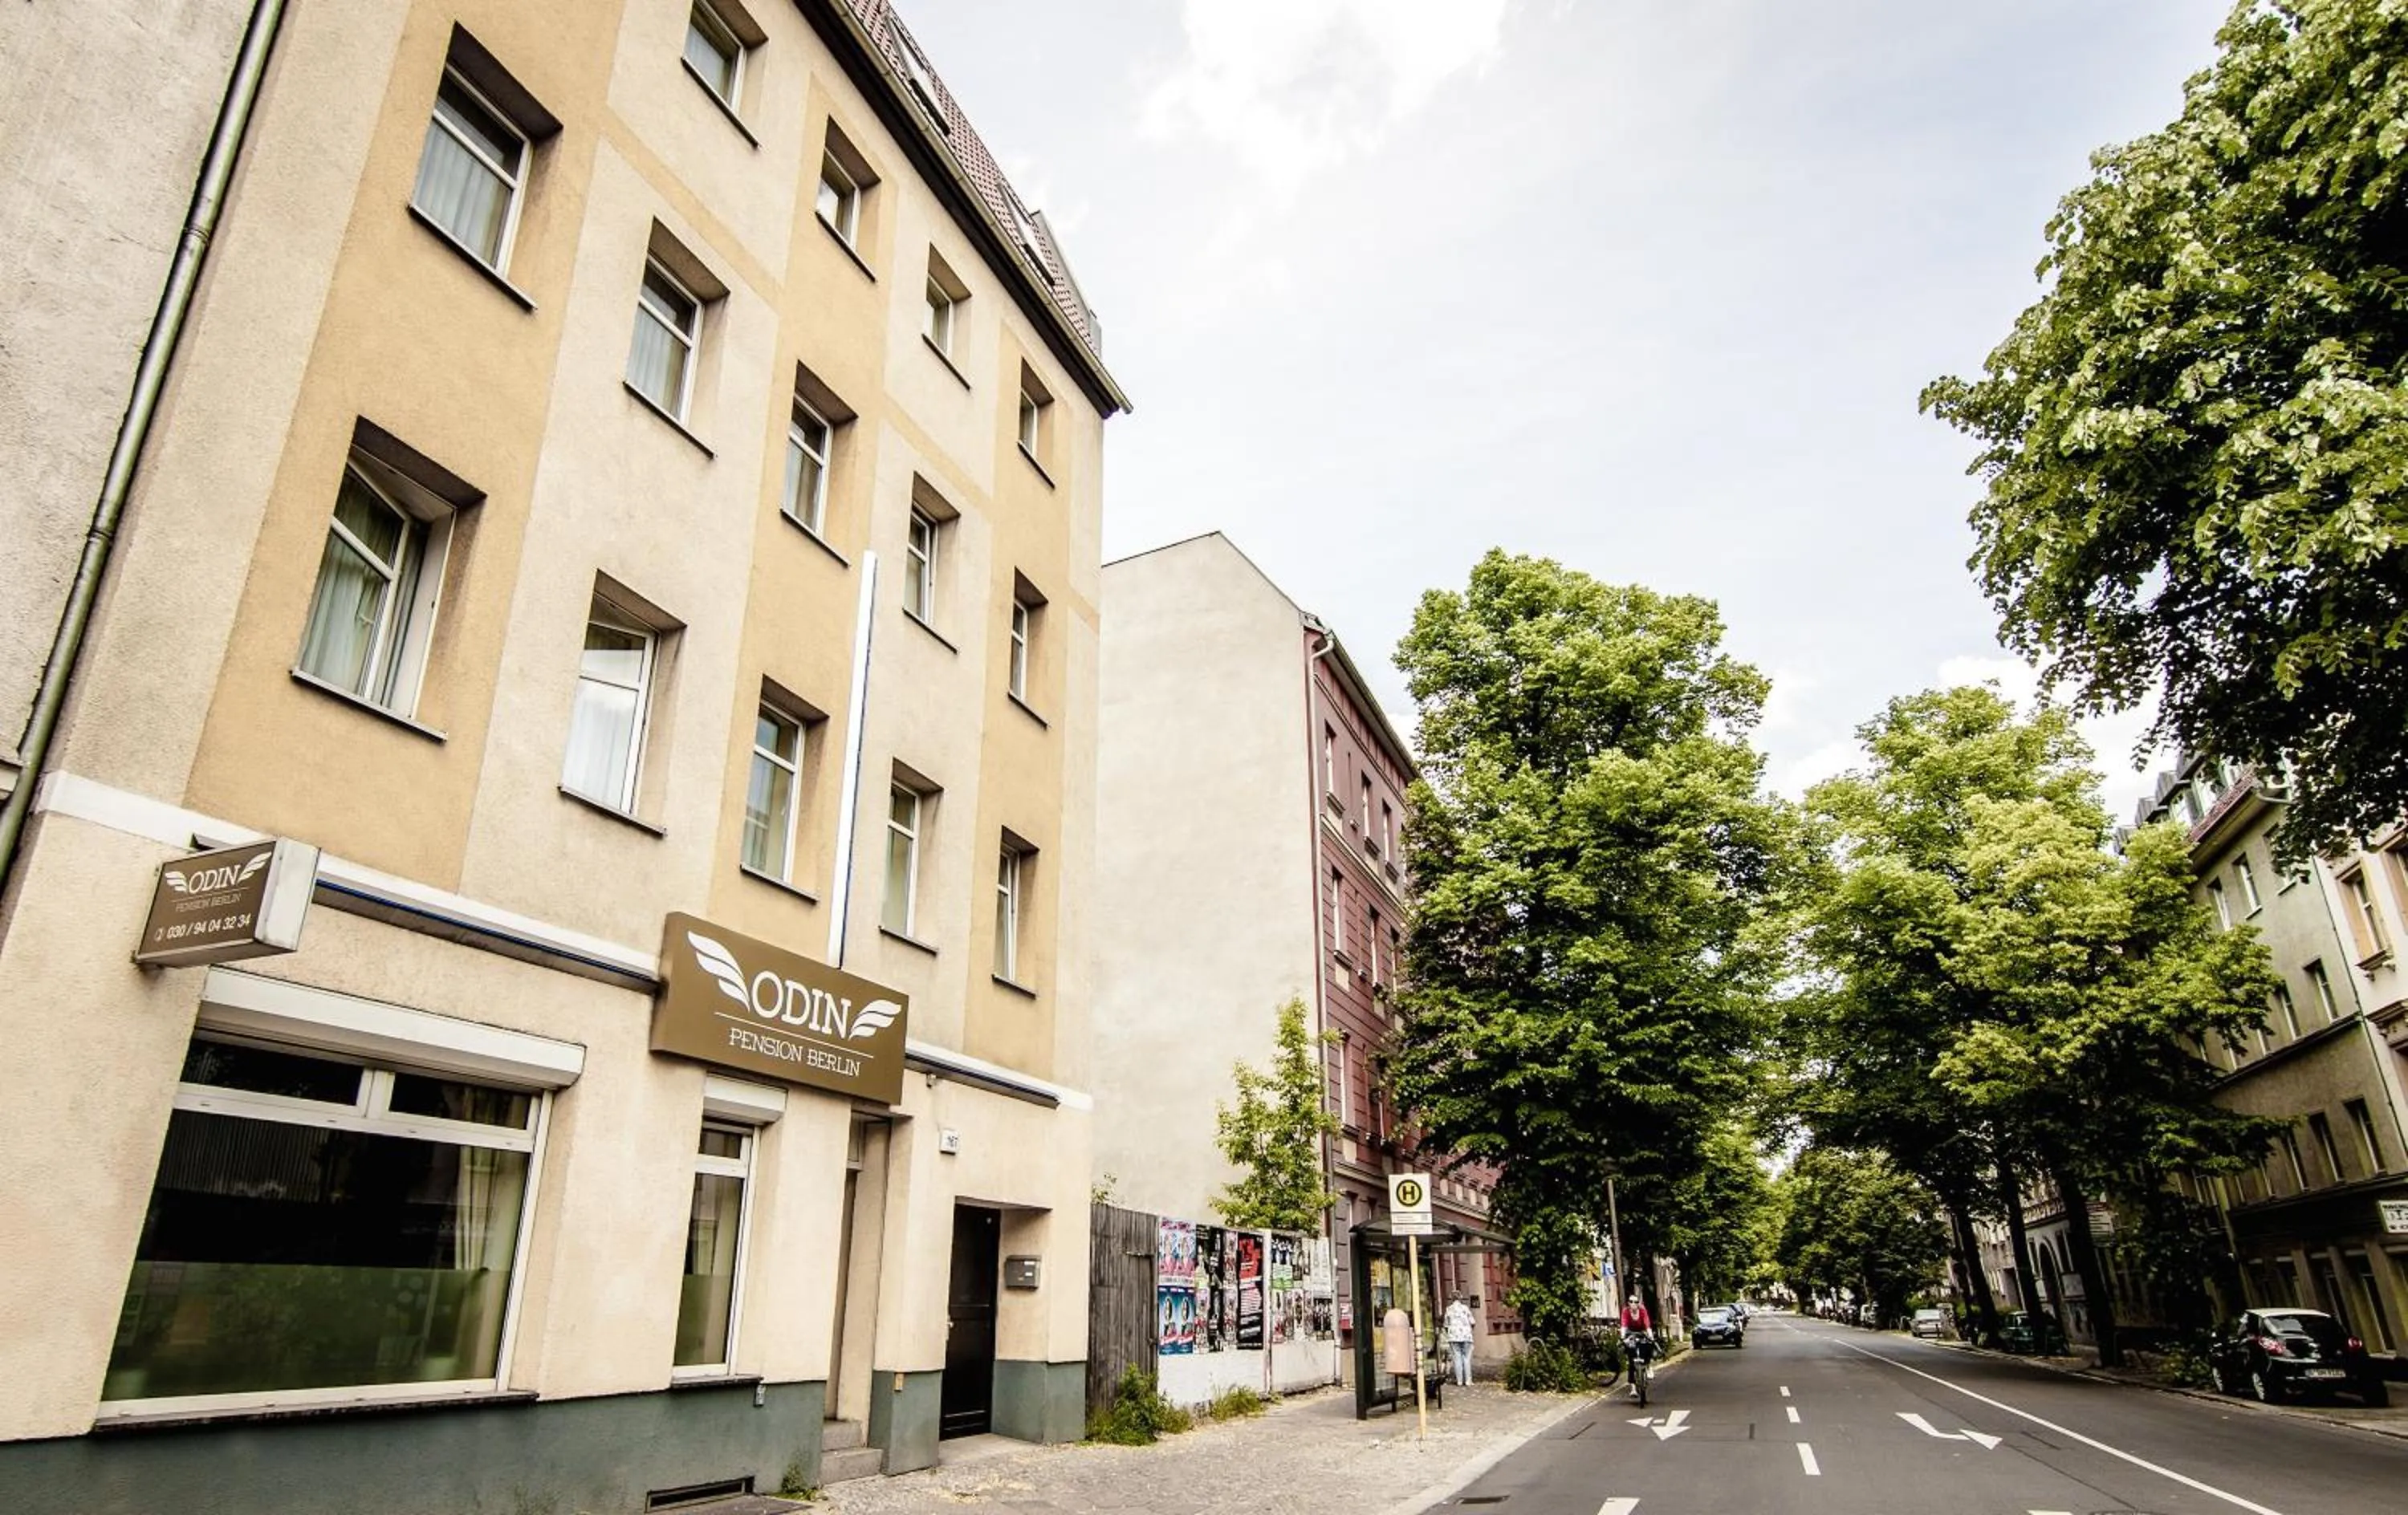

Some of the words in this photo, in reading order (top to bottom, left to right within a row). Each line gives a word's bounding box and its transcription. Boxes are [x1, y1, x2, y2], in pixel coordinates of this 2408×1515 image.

[189, 865, 241, 894] ODIN
[166, 924, 186, 939] 030
[193, 920, 207, 935] 94
[209, 918, 222, 932] 04
[222, 916, 237, 930] 32
[237, 912, 251, 928] 34
[752, 970, 851, 1039] ODIN
[728, 1028, 803, 1062] PENSION
[807, 1048, 861, 1077] BERLIN
[1403, 1185, 1415, 1201] H
